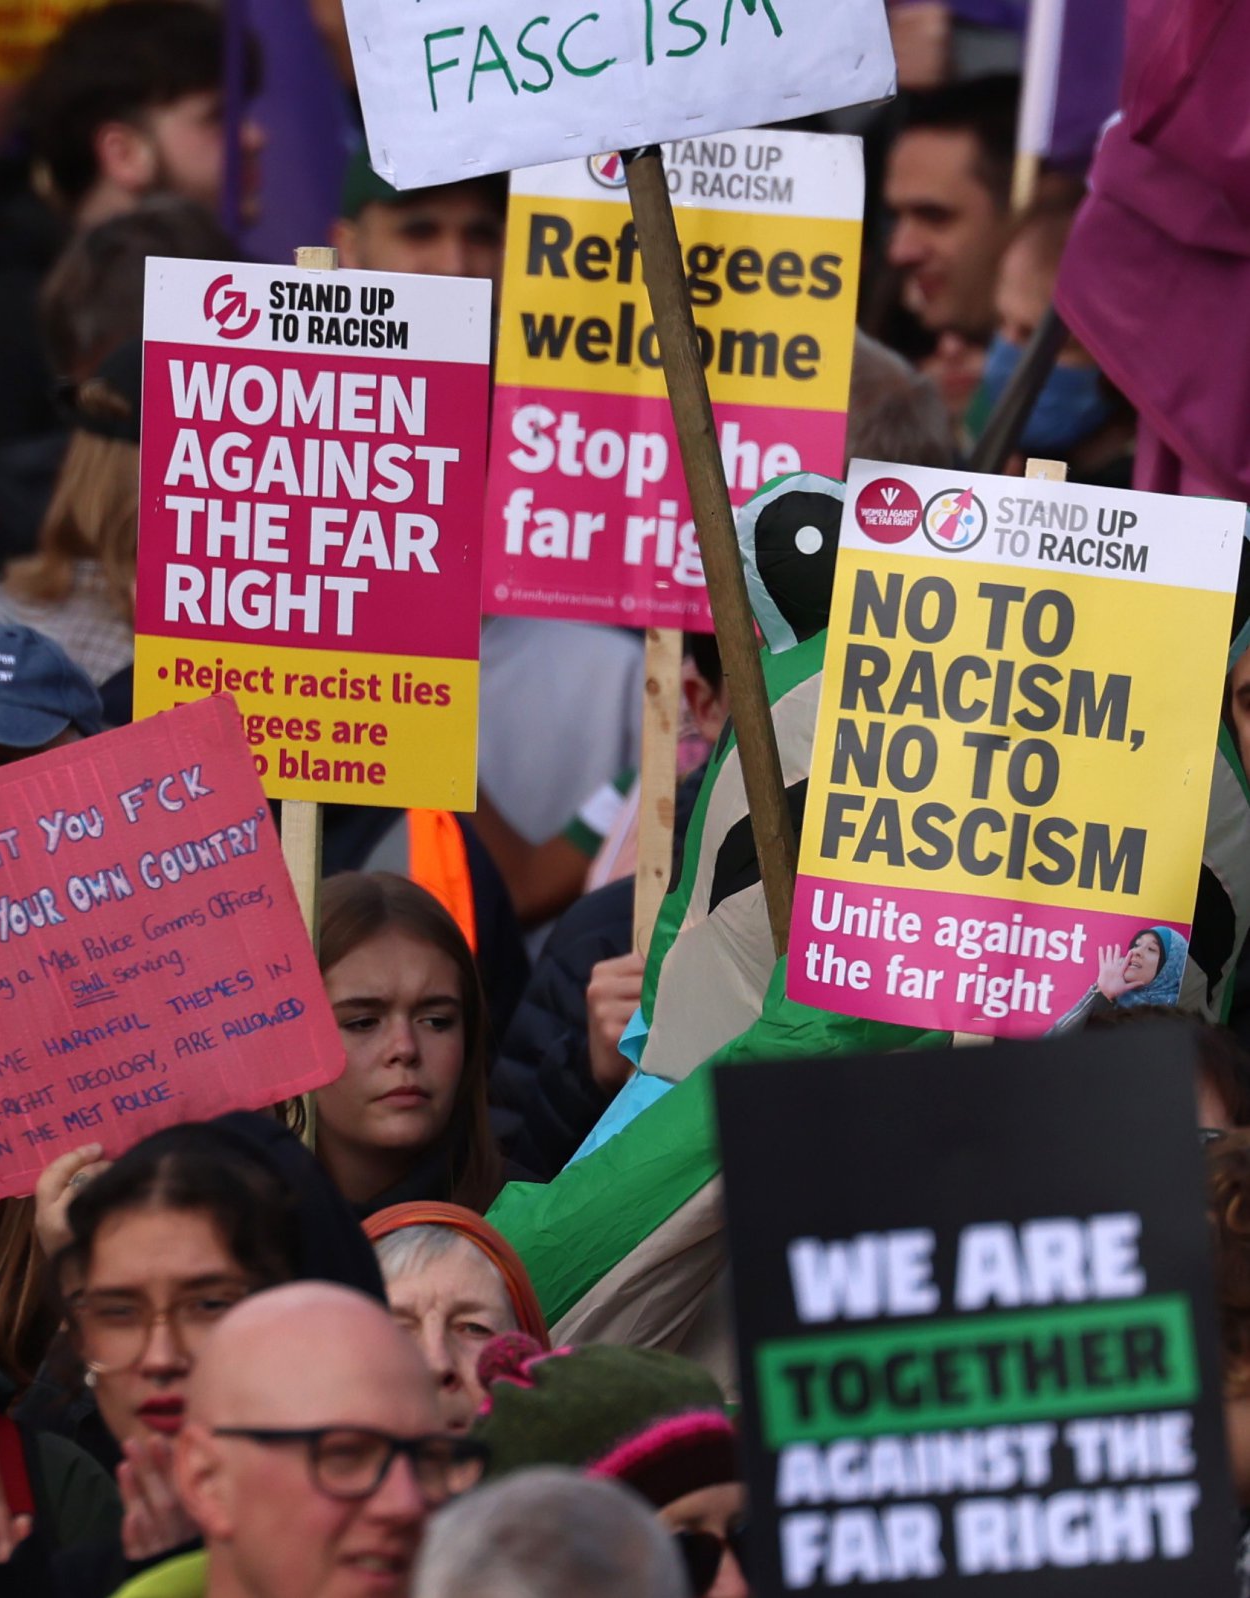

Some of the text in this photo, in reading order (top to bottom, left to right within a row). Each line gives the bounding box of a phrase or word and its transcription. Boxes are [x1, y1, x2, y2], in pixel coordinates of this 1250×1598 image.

[424, 0, 783, 112] FASCISM
[664, 140, 782, 171] TAND UP
[667, 169, 795, 203] O RACISM
[527, 213, 843, 306] Refgees
[269, 280, 395, 316] STAND UP
[269, 313, 409, 350] TO RACISM
[167, 358, 427, 436] WOMEN
[163, 428, 460, 505] AGAINST
[508, 404, 801, 498] Stop he
[165, 495, 440, 574] THE FAR
[503, 487, 707, 588] far rig
[861, 508, 918, 518] WOMEN AGAINST
[865, 517, 914, 526] THE FAR RIGHT
[994, 528, 1149, 573] TO RACISM
[997, 496, 1138, 538] STAND UP
[163, 562, 369, 636] RIGHT
[849, 569, 1075, 658] NO TO
[174, 657, 452, 707] Reject racist lies
[840, 643, 1146, 752] RACISM,
[278, 748, 387, 784] blame
[331, 719, 388, 746] are
[830, 718, 1060, 807] NO TO
[819, 792, 1148, 896] FASCISM
[67, 864, 134, 913] OWN
[18, 970, 35, 984] a
[38, 950, 80, 979] Met
[81, 932, 135, 962] Police
[142, 908, 206, 941] Comms
[810, 889, 1087, 965] Unite against
[166, 969, 254, 1015] THEMES
[265, 953, 293, 981] IN
[805, 941, 1054, 1019] the far right
[67, 1050, 168, 1094] IDEOLOGY,
[174, 1027, 219, 1059] ARE
[221, 996, 306, 1042] ALLOWED
[22, 1122, 59, 1148] THE
[62, 1102, 105, 1132] MET
[787, 1212, 1146, 1324] WE ARE
[781, 1324, 1170, 1423] TOGETHER
[776, 1411, 1196, 1506] AGAINST THE
[780, 1481, 1200, 1589] FAR RIGHT
